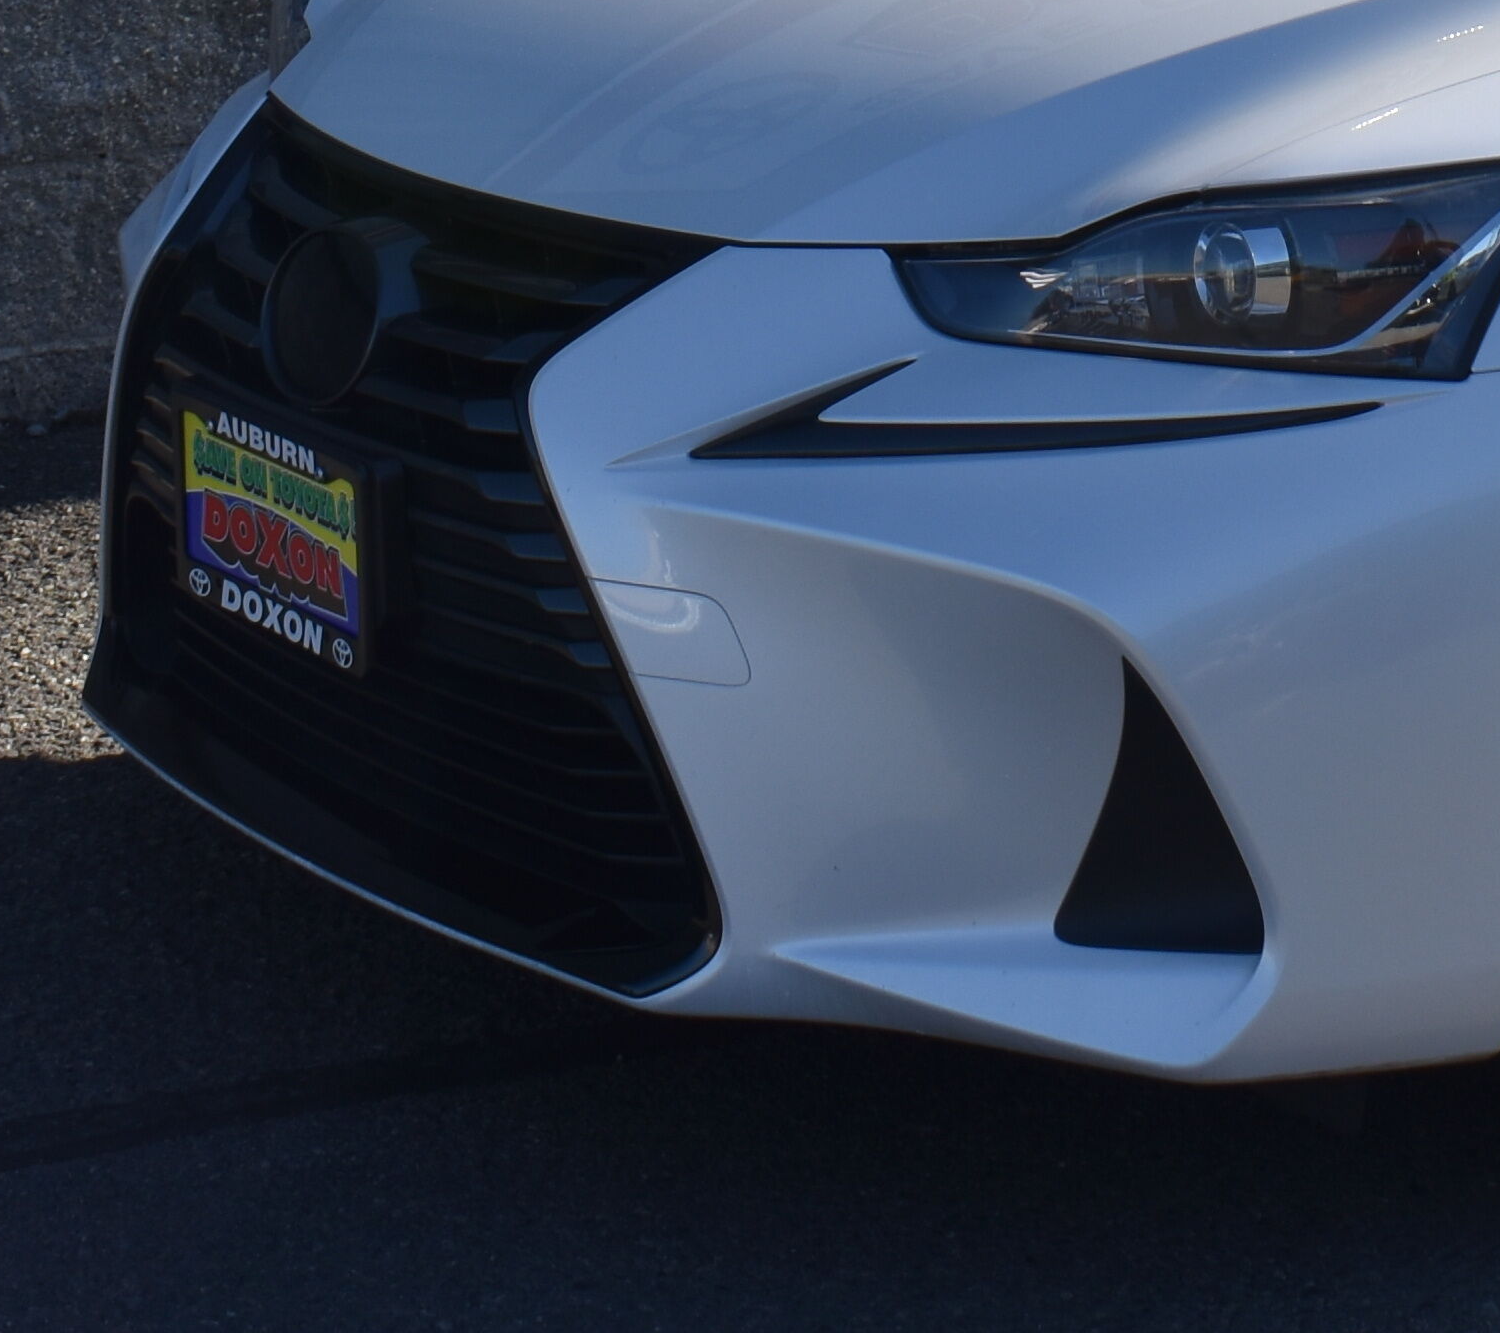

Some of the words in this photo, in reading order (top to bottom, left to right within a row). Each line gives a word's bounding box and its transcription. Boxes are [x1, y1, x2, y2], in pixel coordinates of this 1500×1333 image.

[216, 411, 315, 475] AUBURN
[202, 490, 343, 599] DOXON
[221, 579, 323, 655] DOXON
